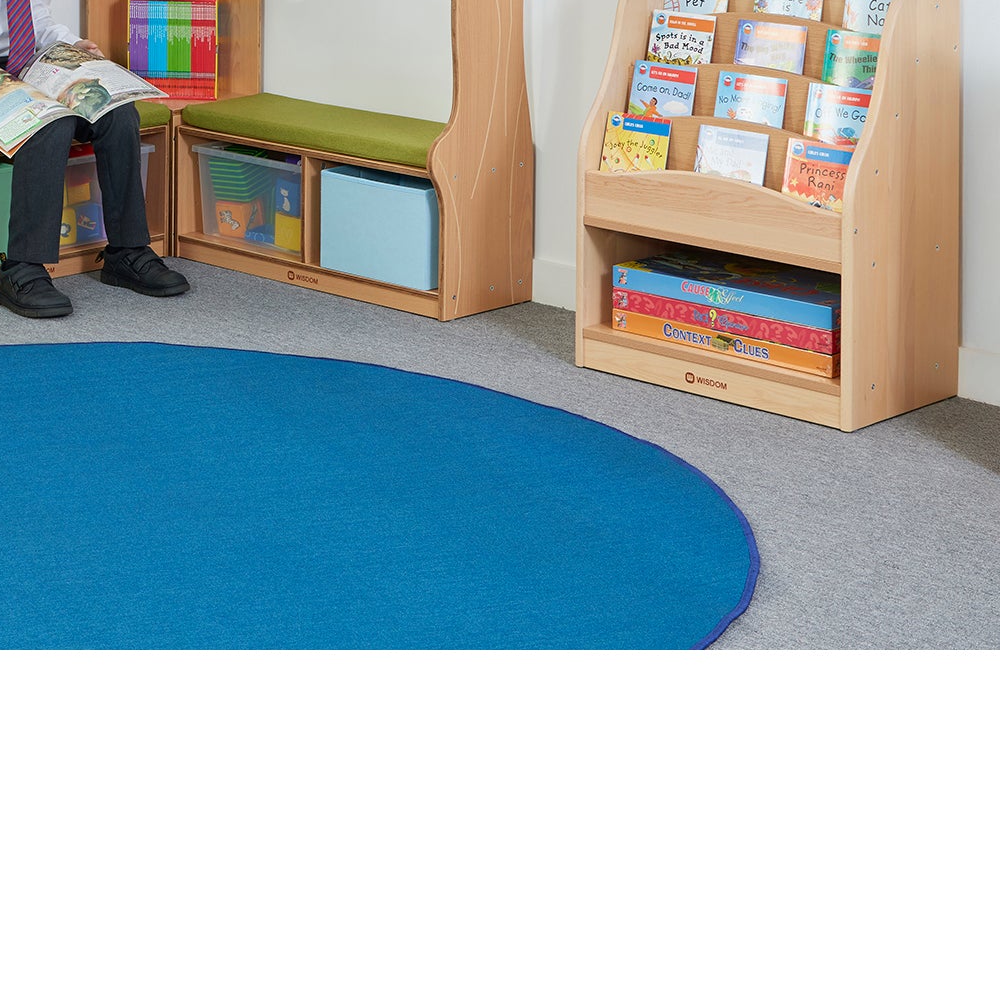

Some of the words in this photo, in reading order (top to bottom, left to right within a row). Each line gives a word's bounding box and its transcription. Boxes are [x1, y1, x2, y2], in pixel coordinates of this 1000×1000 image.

[656, 32, 678, 42] Spots
[689, 35, 696, 43] in
[682, 43, 704, 54] Mood
[637, 82, 657, 92] Come
[673, 89, 691, 101] Dad!
[719, 96, 729, 104] No
[800, 163, 846, 180] Princess
[808, 176, 835, 190] Rani
[296, 274, 318, 284] WISDOM
[681, 281, 710, 296] CAUSE
[720, 289, 744, 304] Effect
[663, 323, 712, 346] CONTEXT
[733, 339, 769, 360] CLUES
[696, 376, 728, 390] WISDOM
